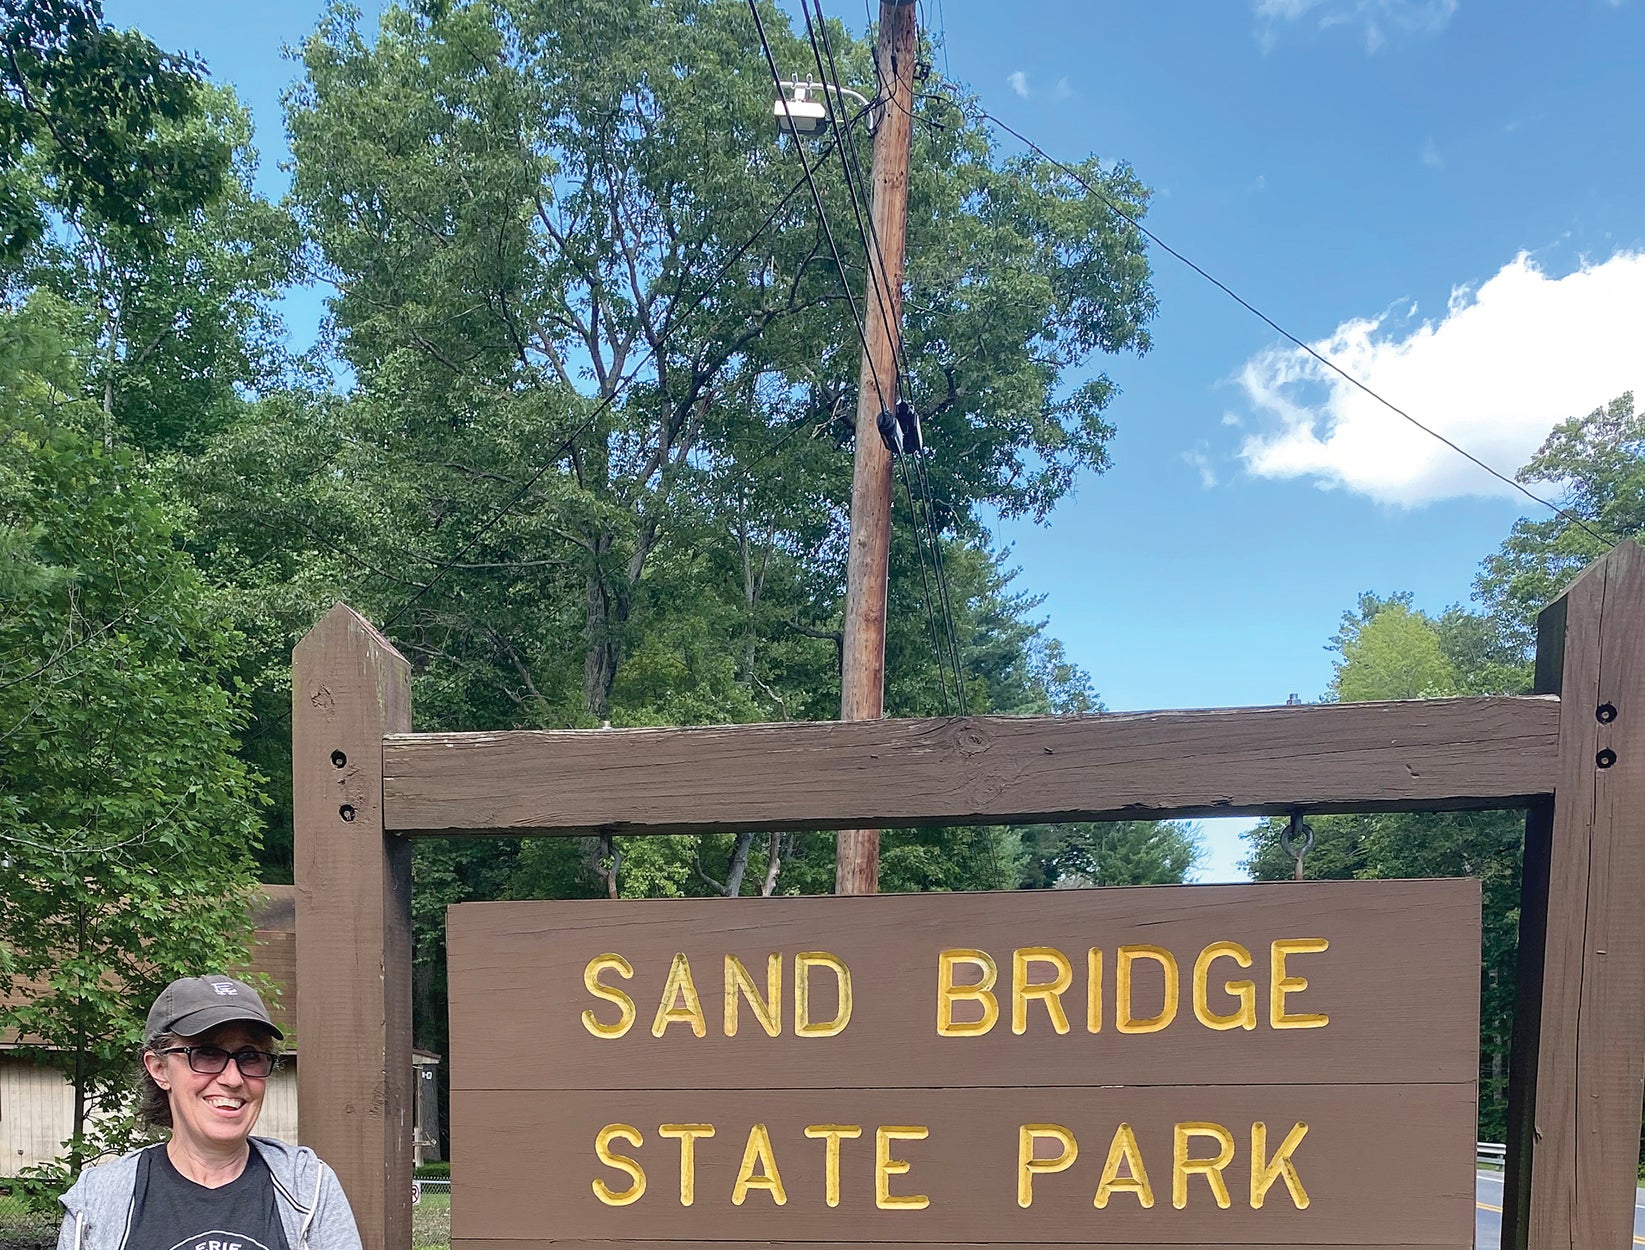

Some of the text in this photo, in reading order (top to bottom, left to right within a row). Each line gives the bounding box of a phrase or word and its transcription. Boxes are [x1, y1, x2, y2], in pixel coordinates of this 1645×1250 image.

[581, 937, 1330, 1039] SAND BRIDGE
[590, 1121, 1311, 1211] STATE PARK
